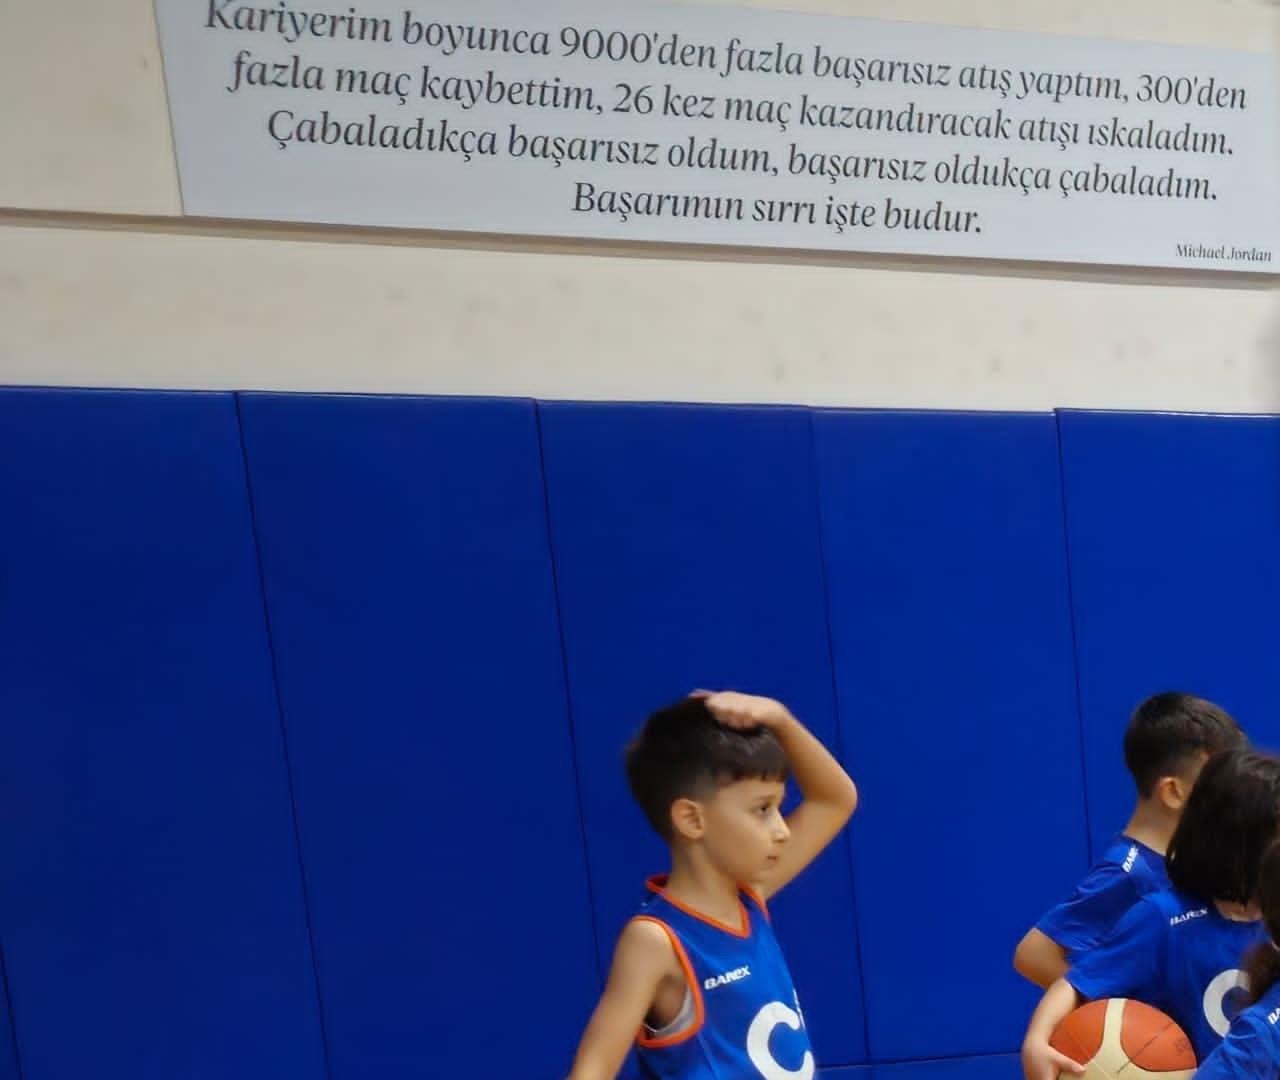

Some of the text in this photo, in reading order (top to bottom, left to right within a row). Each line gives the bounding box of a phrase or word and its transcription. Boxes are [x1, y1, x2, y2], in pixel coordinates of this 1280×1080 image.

[204, 0, 1246, 110] Kariyerim boyunca 9000'den fazla başarısız atış yaptım, 300'den
[226, 52, 1232, 155] fazla maç kaybettim, 26 kez maç kazandıracak atışı ıskaladım.
[268, 110, 1216, 200] Çabaladıkça başarısız oldum, başarısız oldukça çabaladım.
[571, 182, 981, 234] Başarımın sırrı işte budur.
[1176, 243, 1272, 262] Michael Jordan
